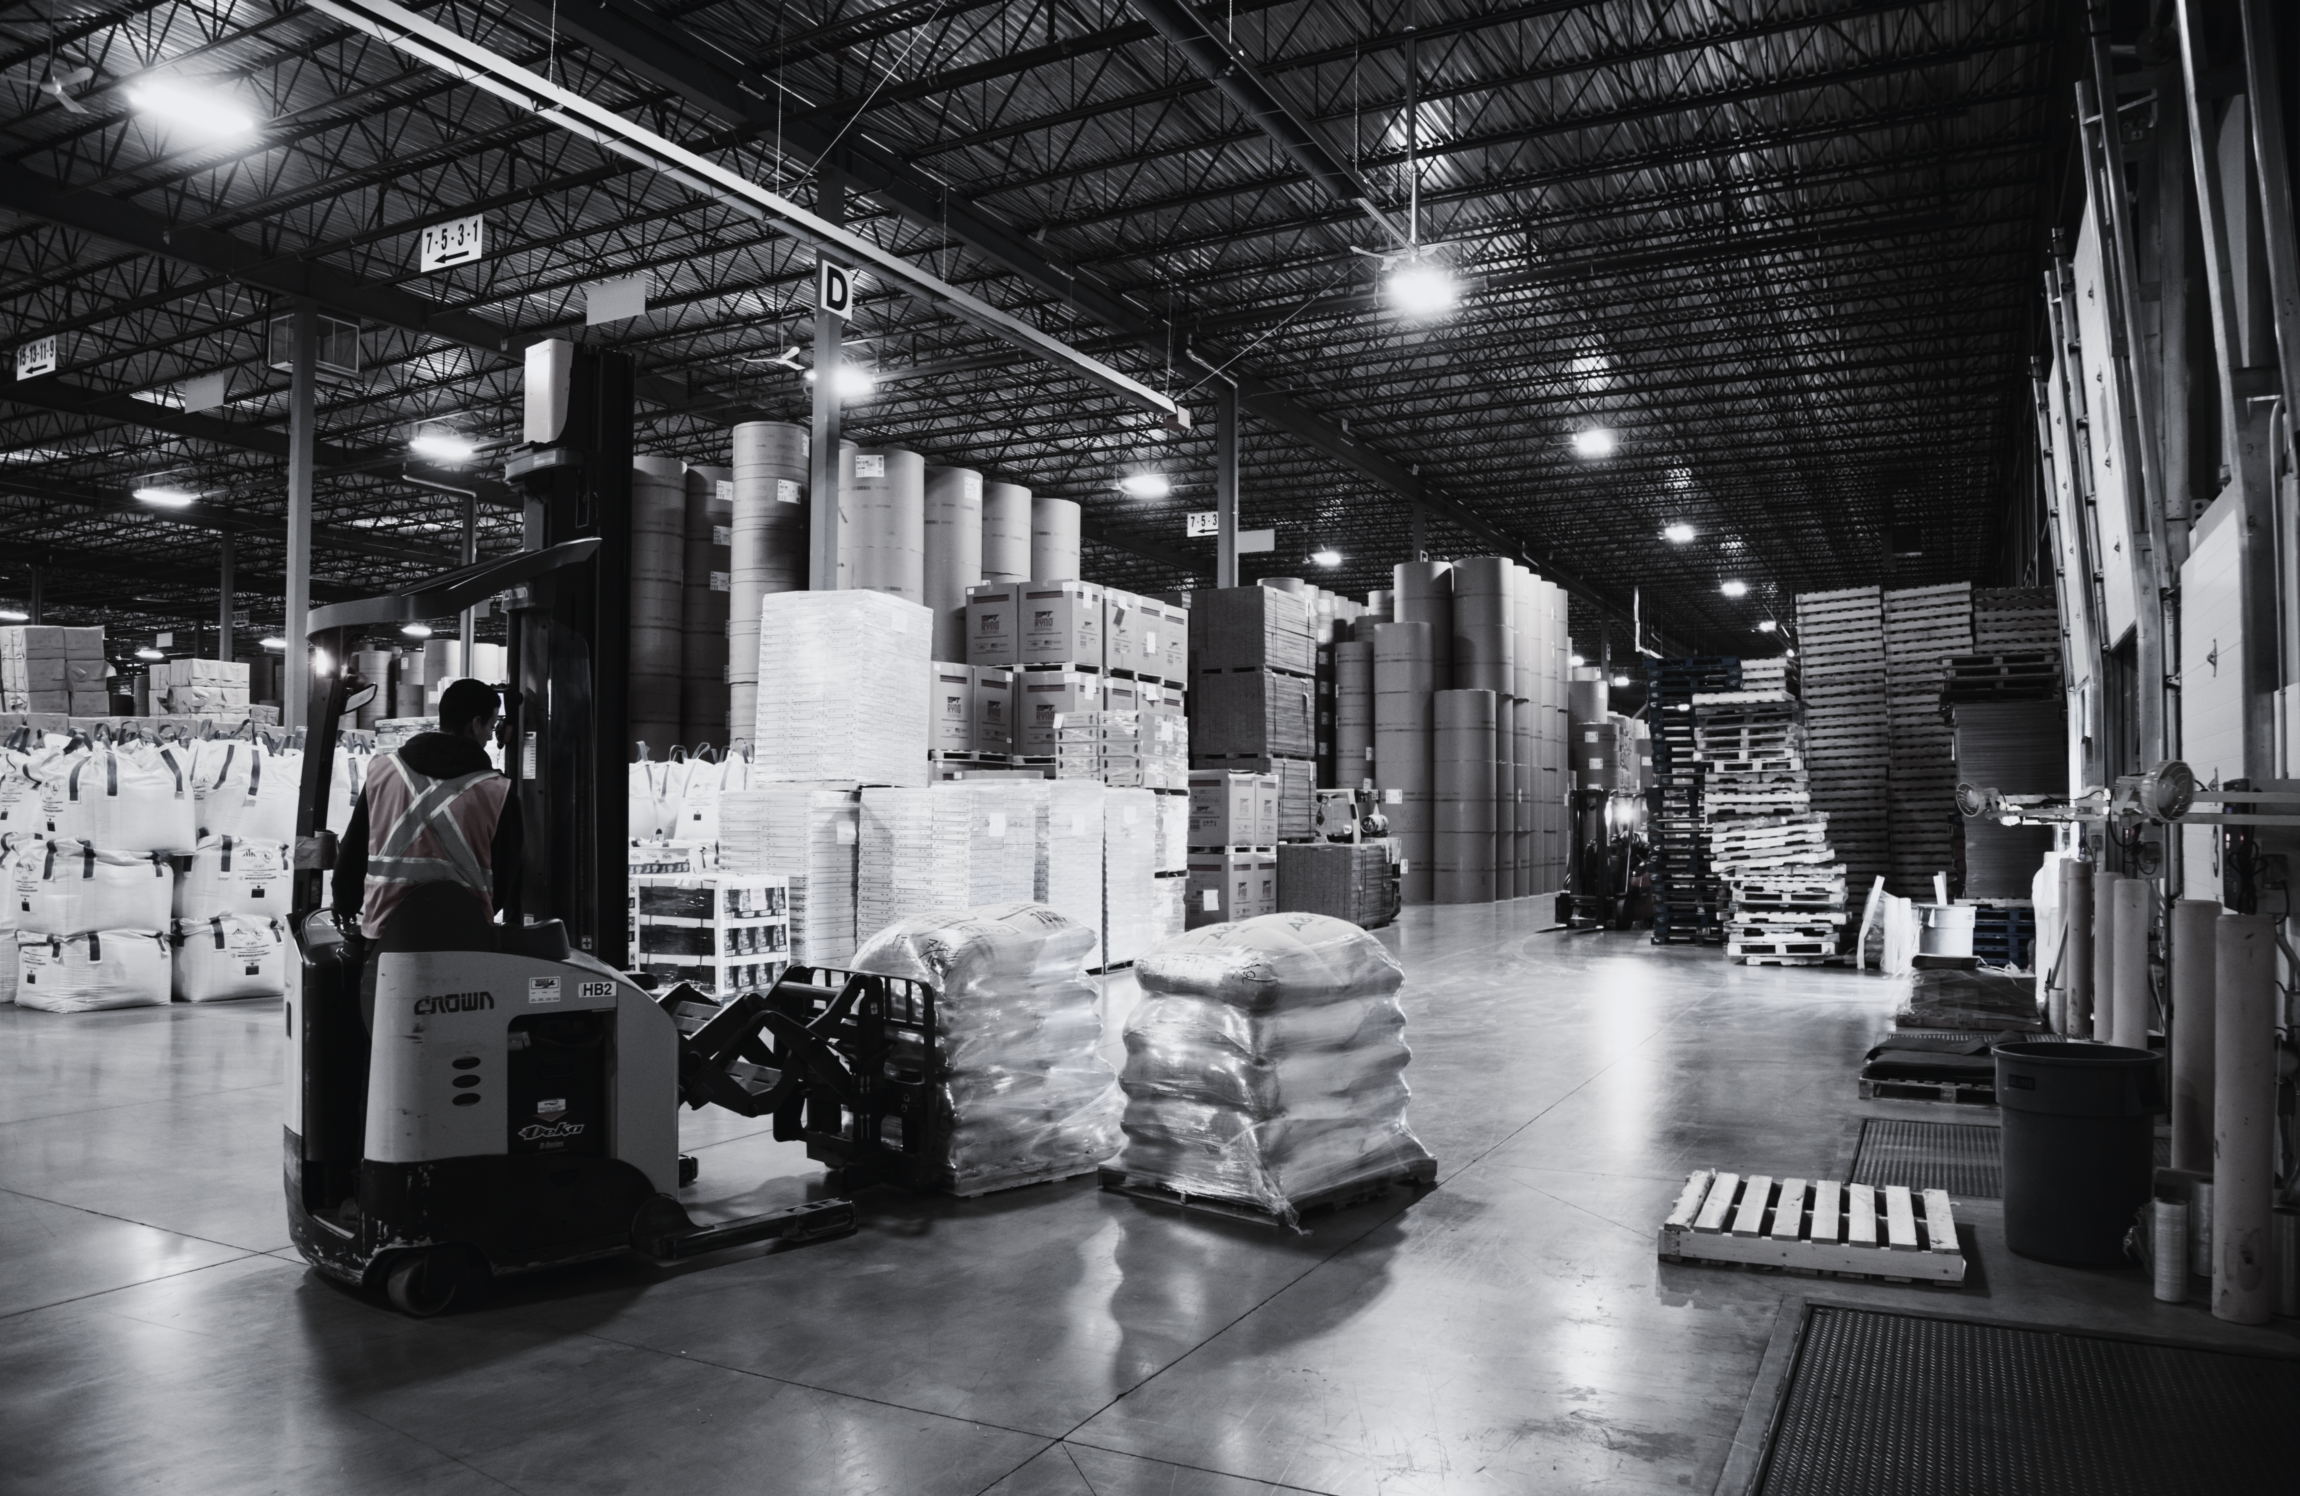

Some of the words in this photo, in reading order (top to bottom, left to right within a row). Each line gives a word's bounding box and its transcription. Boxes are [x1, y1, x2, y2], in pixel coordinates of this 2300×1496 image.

[826, 265, 848, 311] D
[1034, 617, 1054, 628] RYNO
[582, 983, 613, 997] HB2
[413, 991, 495, 1016] CROWN
[2009, 1075, 2034, 1089] ULINE
[518, 1121, 585, 1141] Deka
